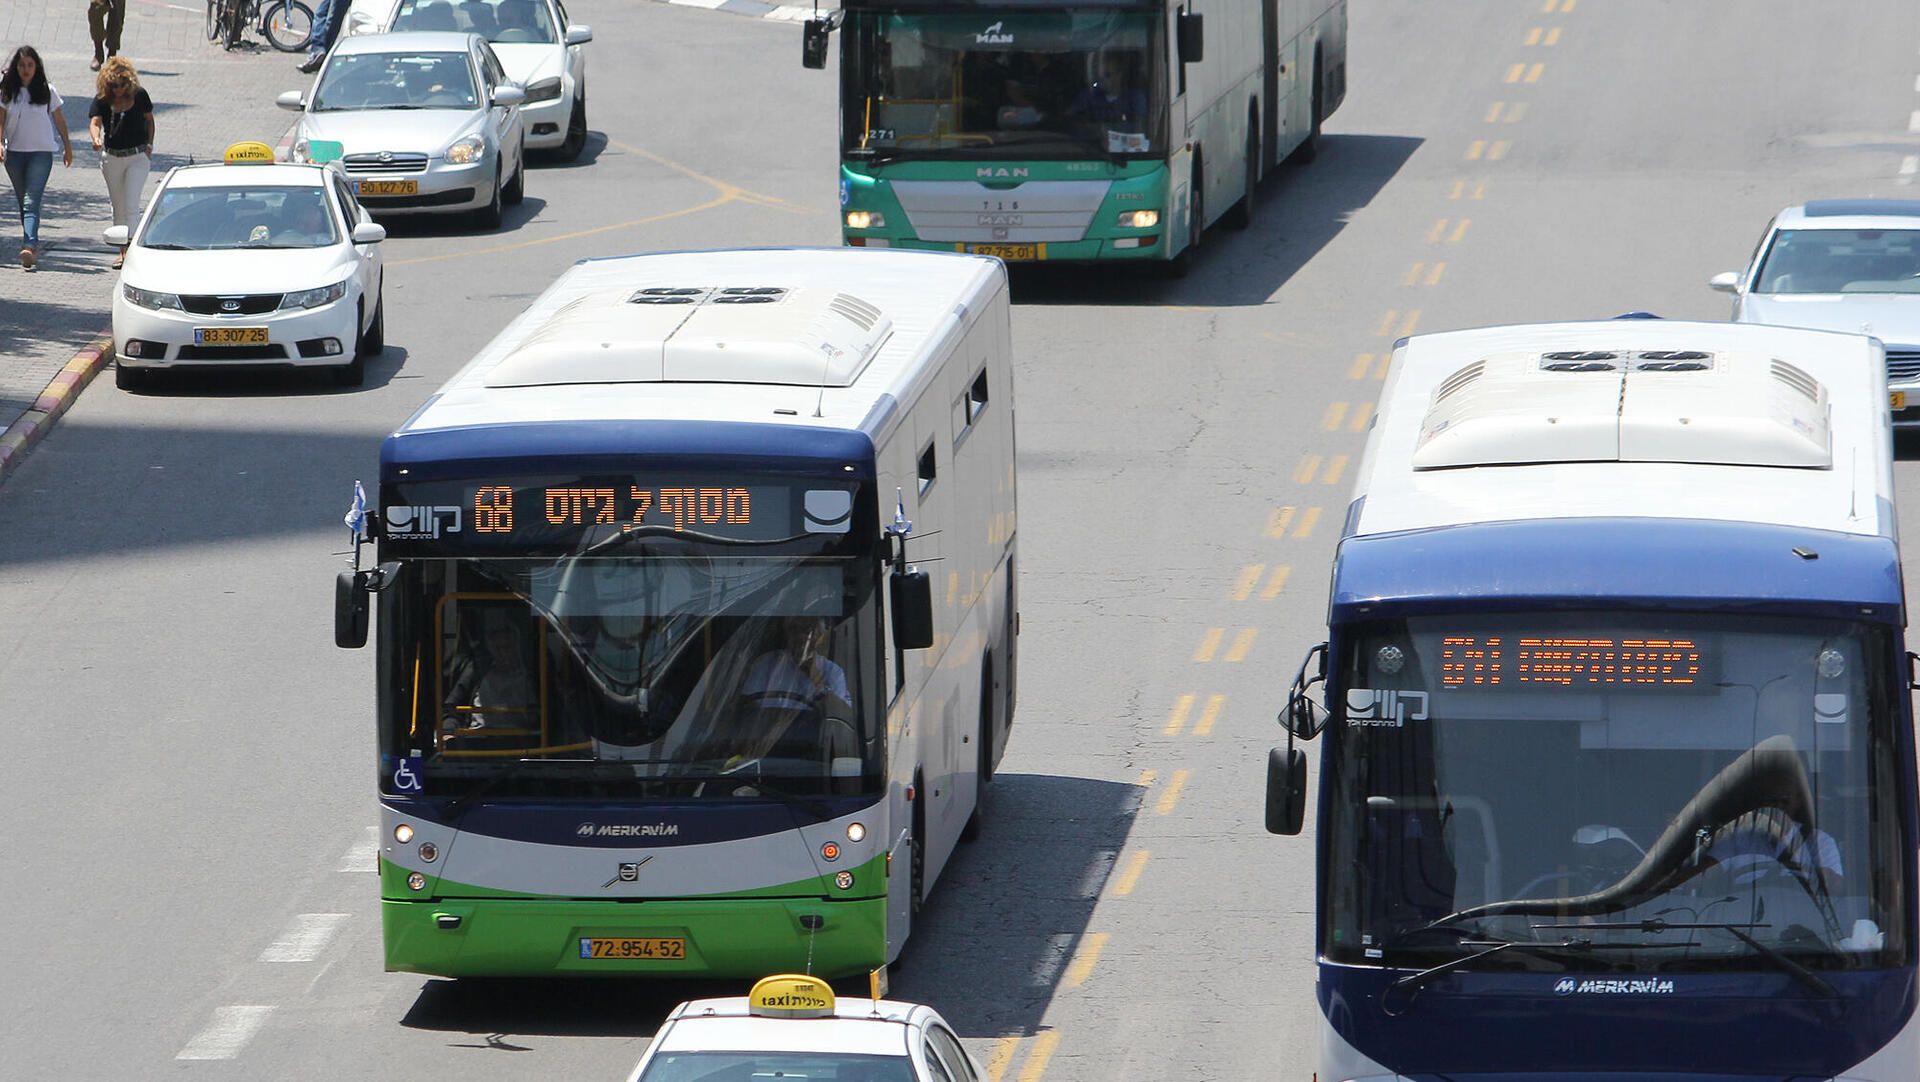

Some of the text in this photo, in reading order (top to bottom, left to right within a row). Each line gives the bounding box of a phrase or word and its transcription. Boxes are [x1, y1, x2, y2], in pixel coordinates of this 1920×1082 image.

[976, 34, 1013, 43] MAN
[869, 130, 895, 139] 271
[976, 168, 1029, 177] MAN
[978, 215, 1022, 225] MAN
[474, 485, 513, 533] 68
[545, 487, 615, 524] גיוס
[659, 487, 750, 532] מסוף
[1621, 639, 1699, 684] פתח
[762, 993, 789, 1006] taxi
